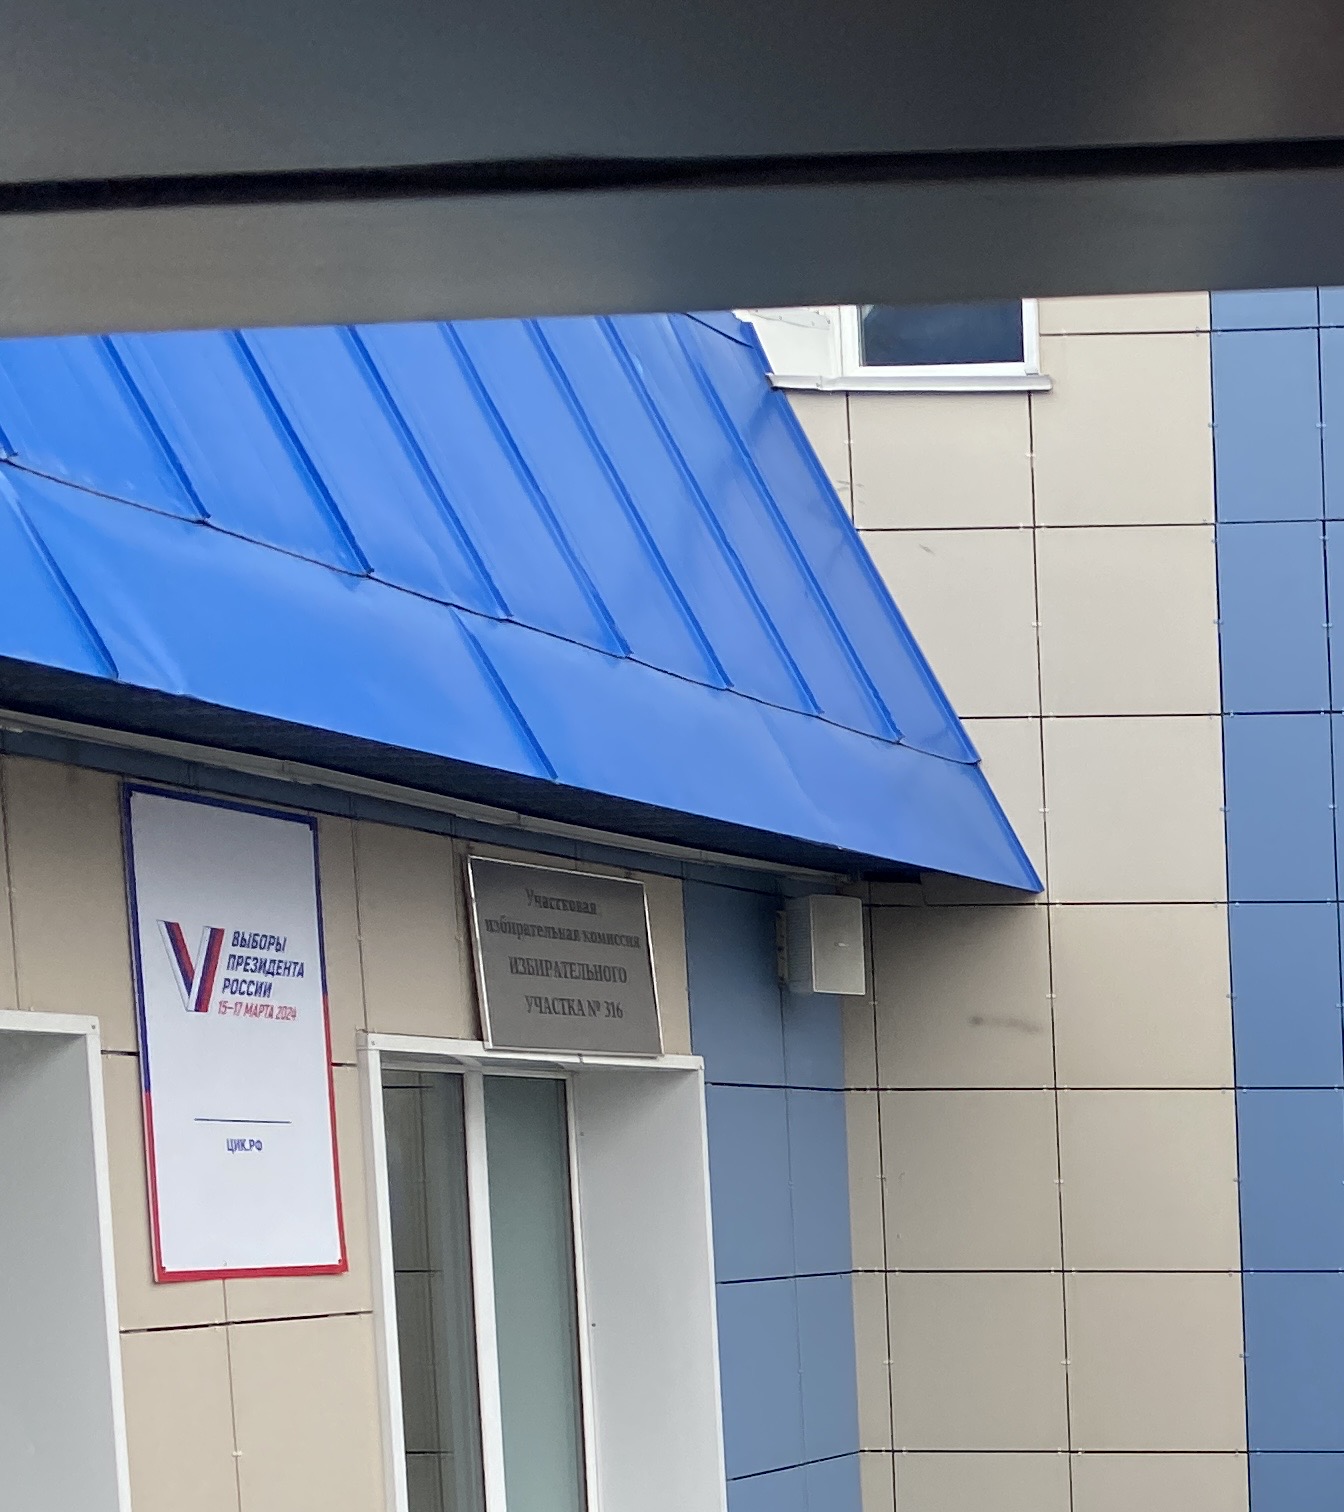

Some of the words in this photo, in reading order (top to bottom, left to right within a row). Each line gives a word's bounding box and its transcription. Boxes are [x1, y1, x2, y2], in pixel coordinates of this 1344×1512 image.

[525, 888, 598, 915] Участковая
[231, 930, 288, 953] ВЫБОРЫ
[484, 914, 581, 941] избирательная
[582, 929, 641, 949] комиссия
[226, 953, 305, 979] ПРЕЗИДЕНТА
[508, 955, 628, 984] ИЗБИРАТЕЛЬНОГО
[221, 977, 273, 999] РОССИИ
[243, 1001, 275, 1020] МАРТА
[275, 1005, 297, 1021] 2024
[524, 994, 586, 1017] УЧАСТКА
[603, 1000, 624, 1020] 316
[226, 1138, 263, 1155] ЦИК.РФ
